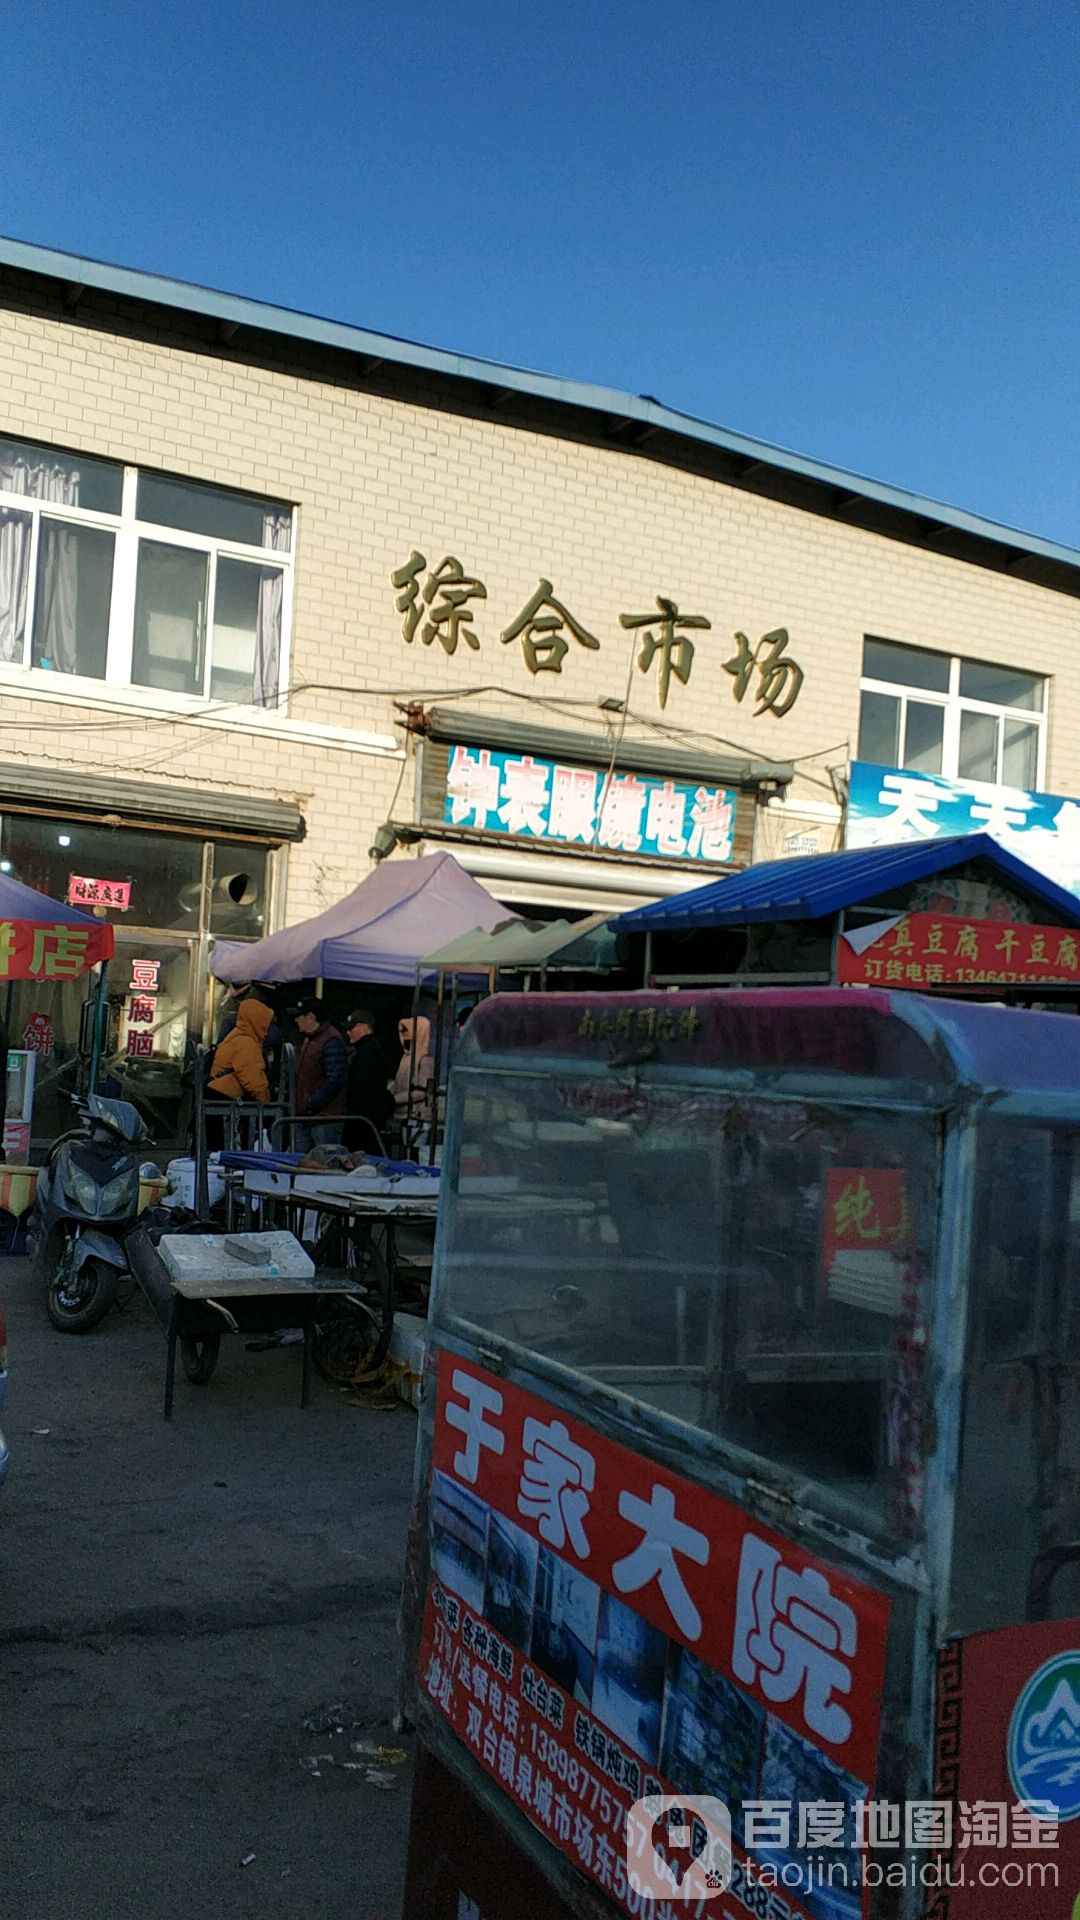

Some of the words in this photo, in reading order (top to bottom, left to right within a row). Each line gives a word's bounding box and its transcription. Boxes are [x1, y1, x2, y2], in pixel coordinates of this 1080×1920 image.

[391, 550, 804, 718] 综合市场
[447, 744, 732, 861] 钟表眼镜电池
[868, 918, 979, 963] 真豆腐
[126, 959, 160, 1057] 豆腐脑
[445, 1370, 858, 1745] 于家大院
[574, 1711, 640, 1799] 铁锅炖鸡
